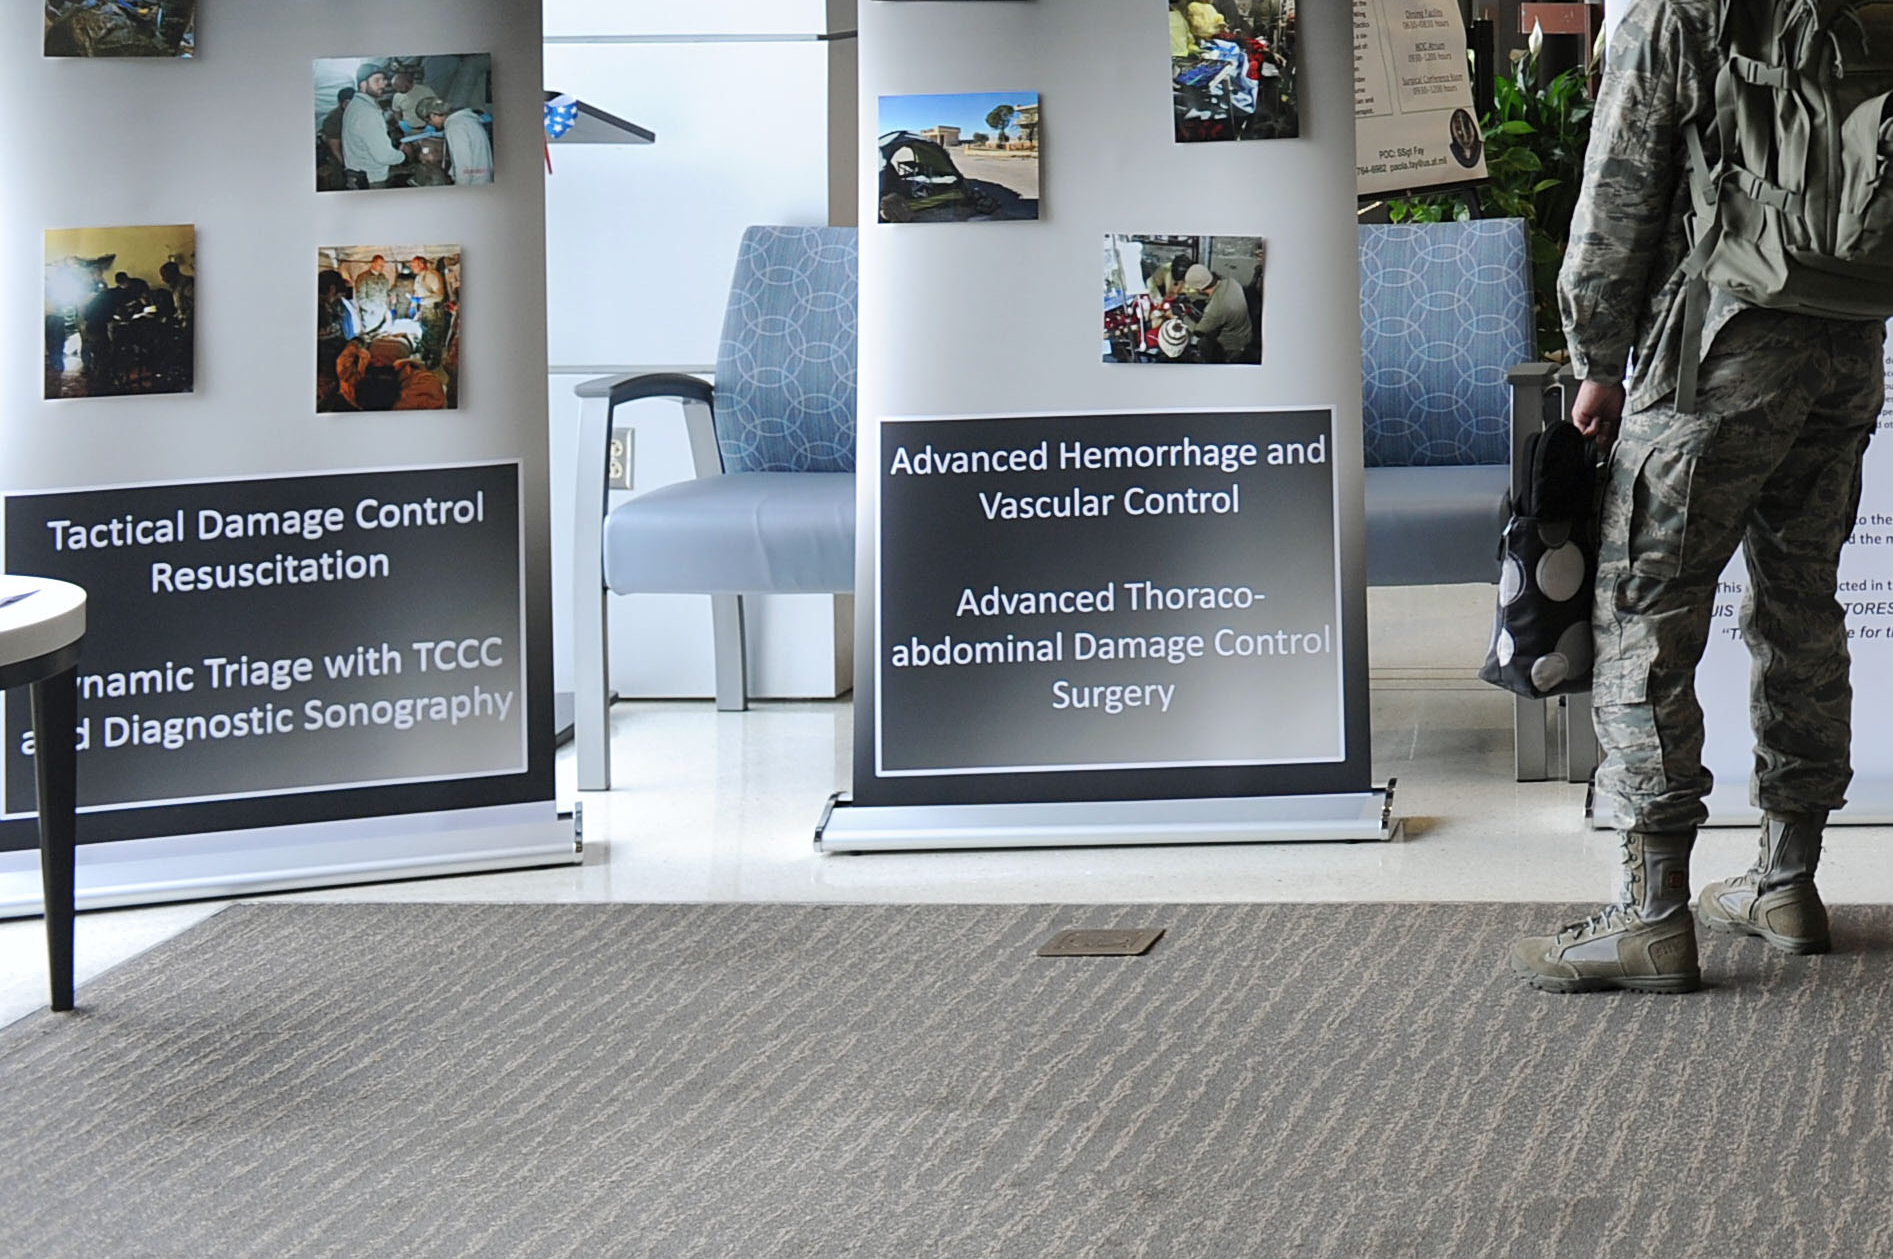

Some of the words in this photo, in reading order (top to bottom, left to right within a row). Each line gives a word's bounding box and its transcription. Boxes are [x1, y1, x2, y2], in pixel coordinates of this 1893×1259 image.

[890, 441, 1047, 475] Advanced
[1059, 437, 1258, 473] Hemorrhage
[1267, 434, 1325, 466] and
[48, 510, 184, 551] Tactical
[199, 506, 345, 541] Damage
[355, 491, 484, 528] Control
[978, 487, 1114, 520] Vascular
[1123, 484, 1239, 517] Control
[1860, 532, 1882, 544] the
[152, 551, 389, 593] Resuscitation
[1871, 580, 1884, 591] in
[956, 583, 1114, 617] Advanced
[1124, 581, 1266, 612] Thoraco-
[891, 632, 1063, 667] abdominal
[1074, 630, 1204, 664] Damage
[1214, 625, 1331, 658] Control
[1860, 626, 1882, 638] for
[77, 662, 194, 699] namic
[205, 654, 312, 691] Triage
[324, 643, 401, 679] with
[412, 638, 503, 673] TCCC
[1052, 679, 1175, 715] Surgery
[21, 718, 89, 755] ad
[104, 703, 293, 750] Diagnostic
[304, 685, 514, 730] Sonography
